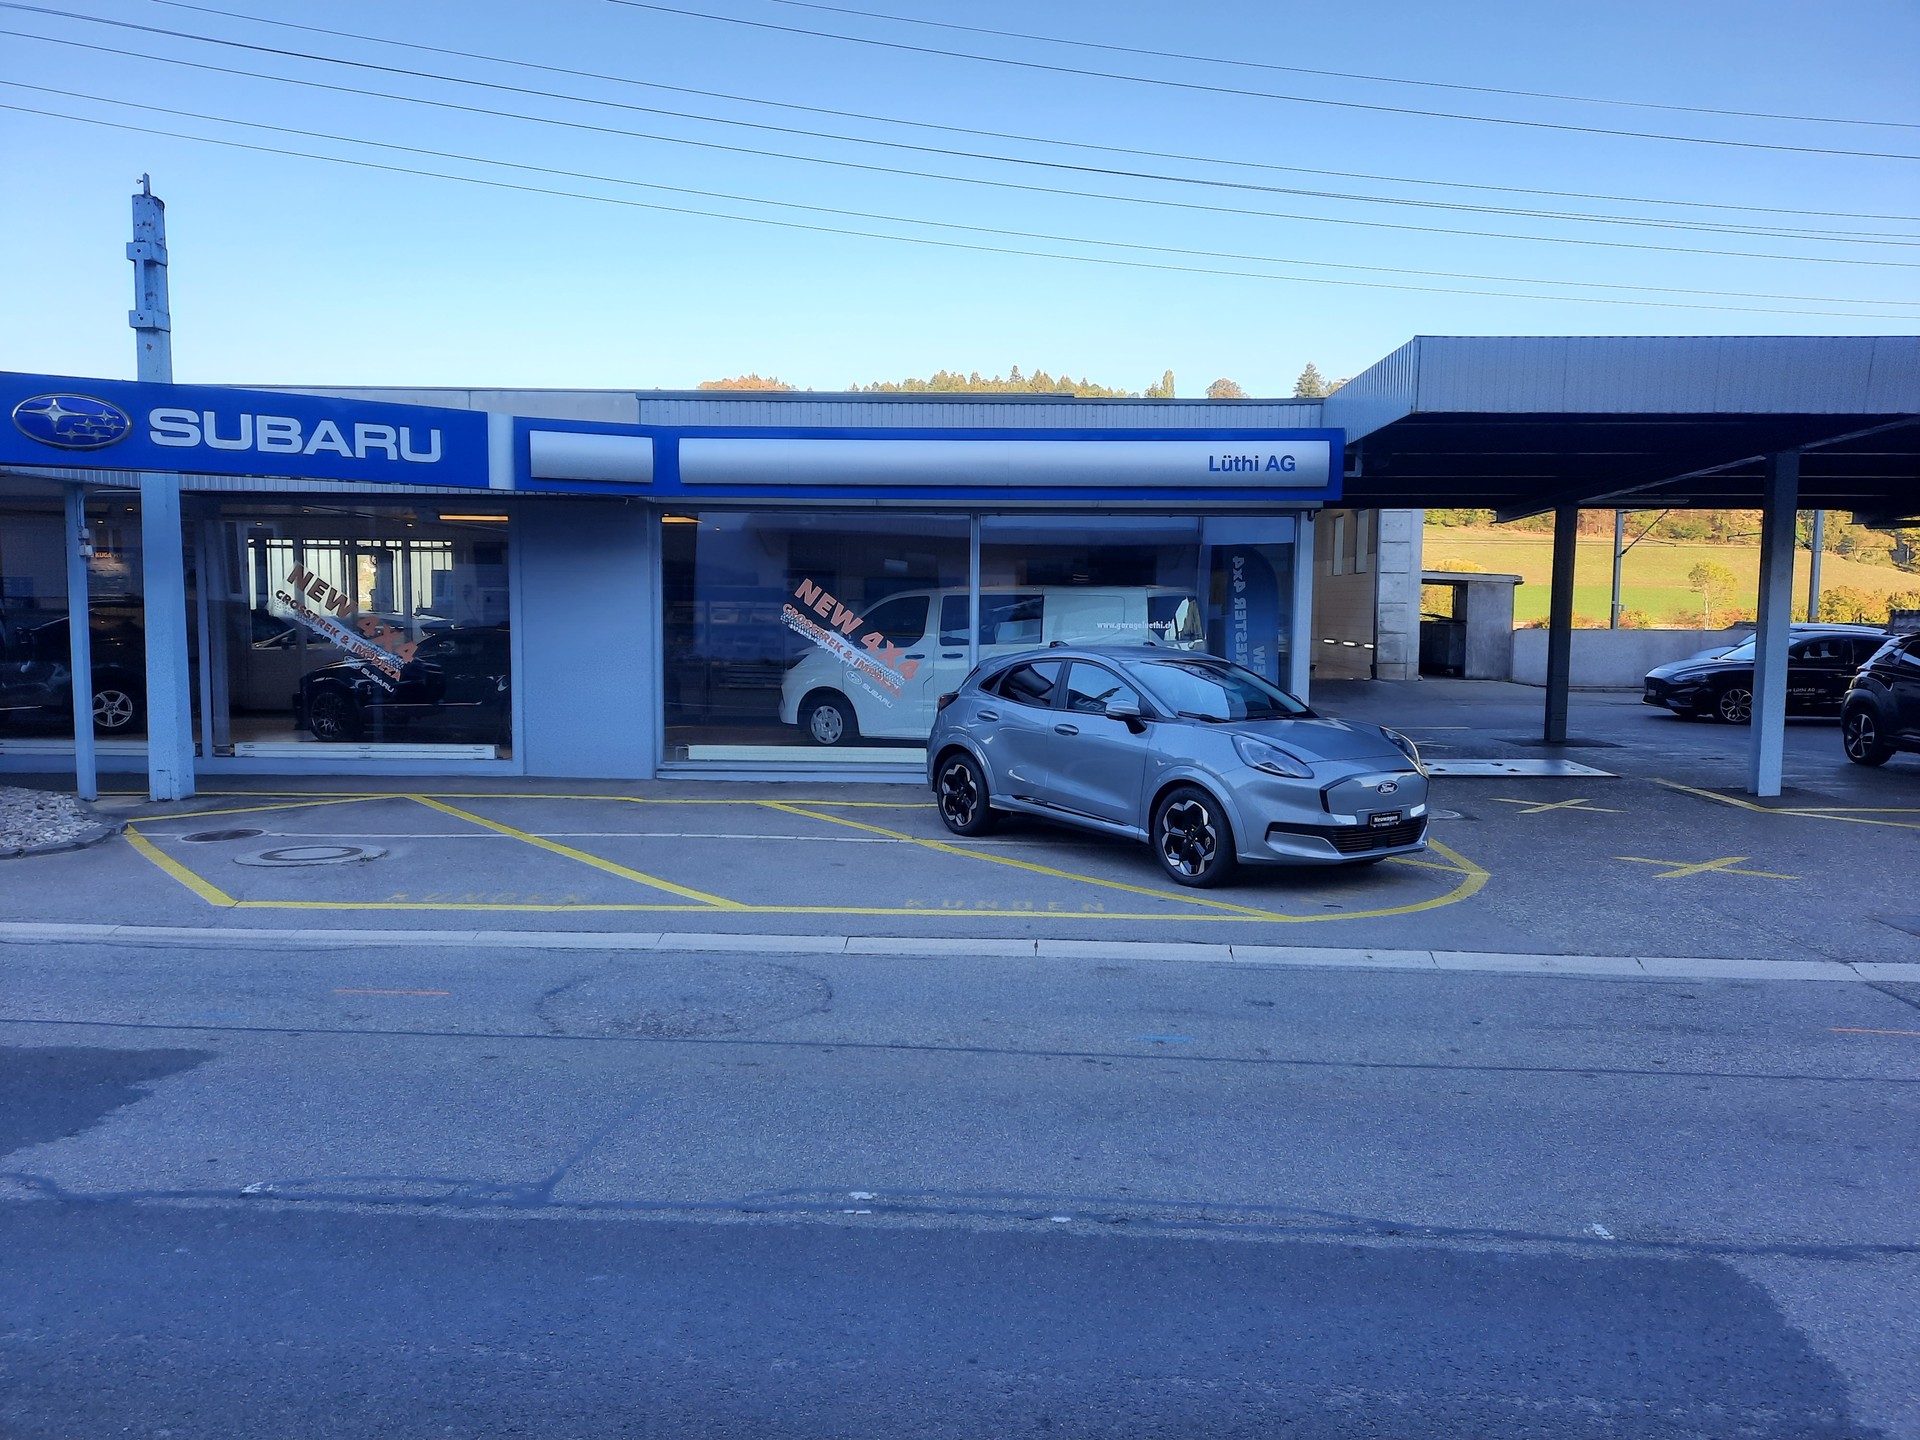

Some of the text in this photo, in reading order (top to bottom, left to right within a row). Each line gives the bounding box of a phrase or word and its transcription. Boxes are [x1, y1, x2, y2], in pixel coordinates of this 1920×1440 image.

[149, 408, 441, 463] SUBARU
[1209, 455, 1296, 472] Lüthi AG
[275, 590, 341, 639] CROSSTREK
[341, 635, 350, 649] &
[287, 565, 418, 664] NEW 4X4
[783, 603, 844, 652] CROSSTREK
[843, 650, 853, 661] &
[794, 578, 920, 679] NEW 4X4
[361, 667, 395, 693] SUBARU
[862, 682, 894, 708] SUBARU
